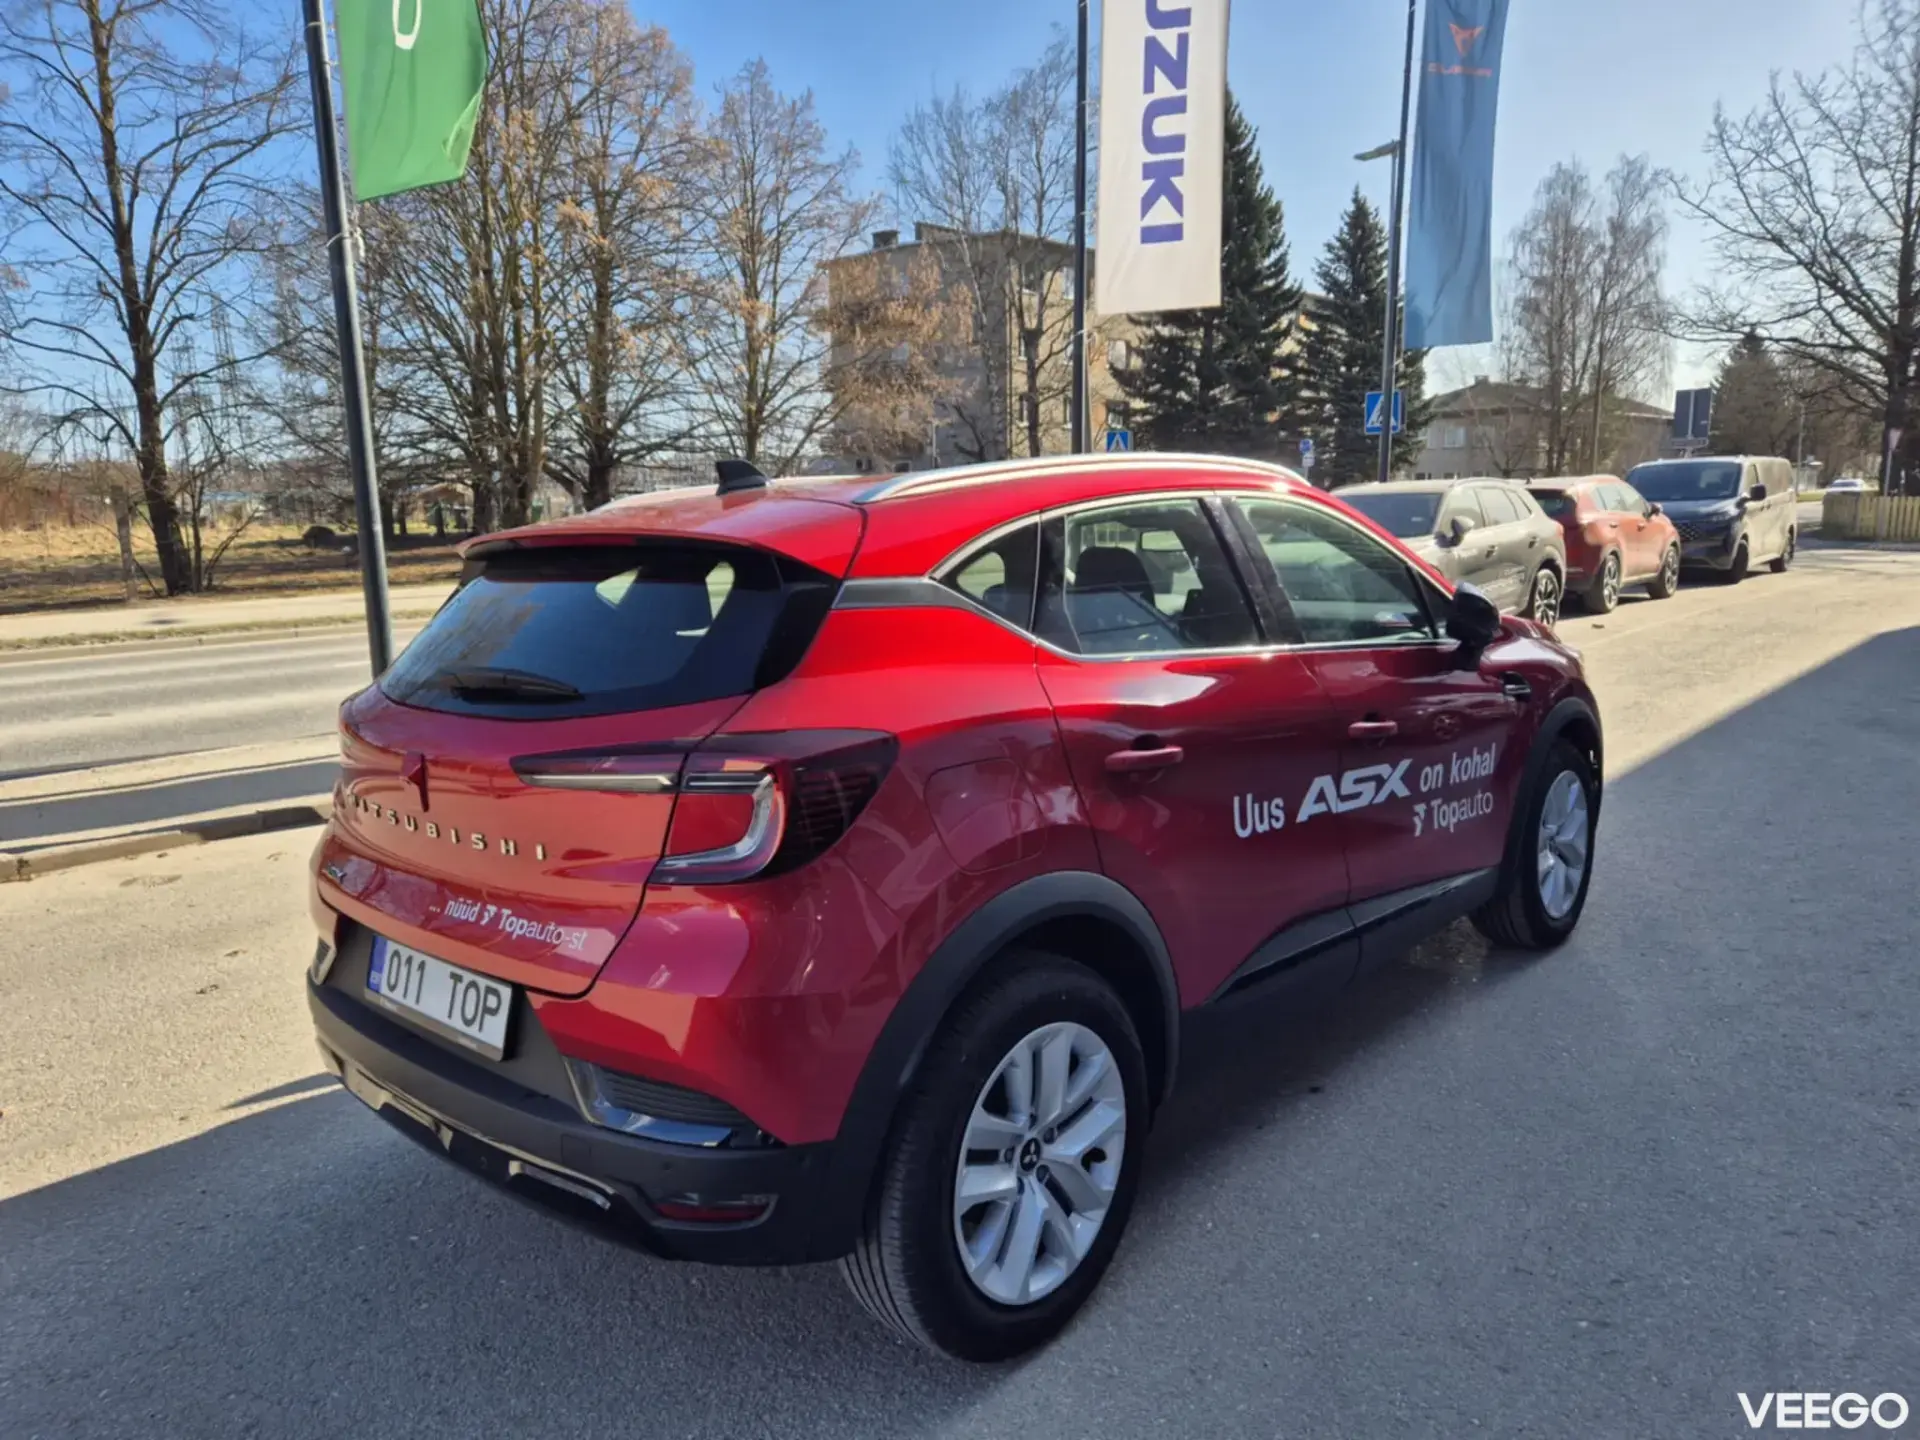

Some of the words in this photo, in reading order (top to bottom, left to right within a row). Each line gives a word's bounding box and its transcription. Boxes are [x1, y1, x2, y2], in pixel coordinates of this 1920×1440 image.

[1233, 793, 1285, 838] Uus
[1296, 759, 1412, 823] ASX
[1420, 763, 1443, 792] on
[1451, 743, 1496, 784] kohal
[1431, 789, 1493, 832] Topauto
[444, 897, 480, 922] nüüd
[388, 949, 426, 1008] 011
[447, 971, 502, 1033] TOP
